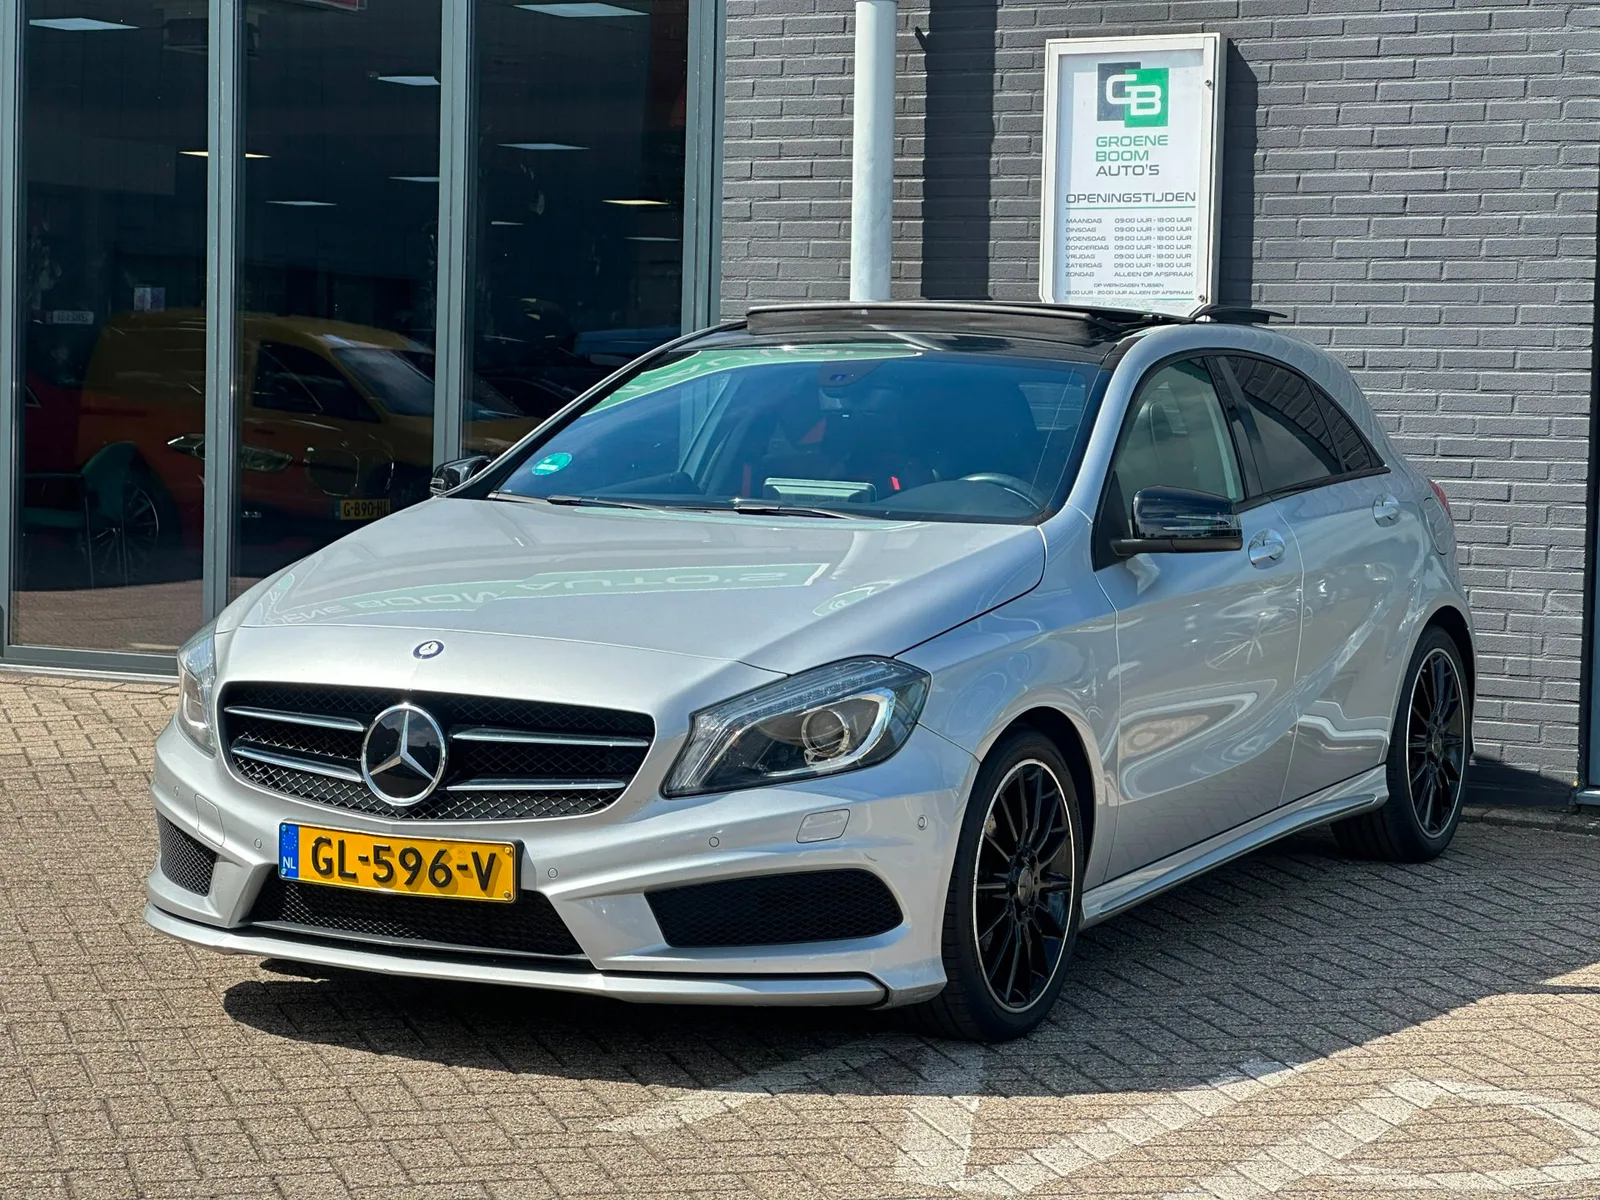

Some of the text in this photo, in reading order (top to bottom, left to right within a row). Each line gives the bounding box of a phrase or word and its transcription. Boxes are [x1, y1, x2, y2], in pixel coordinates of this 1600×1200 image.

[1096, 135, 1168, 148] GROENE
[1096, 150, 1148, 162] BOOM
[1096, 164, 1160, 176] AUTO'S
[1066, 192, 1196, 203] OPENINGSTIJDEN
[282, 856, 297, 870] NL
[311, 836, 497, 891] GL-596-V
